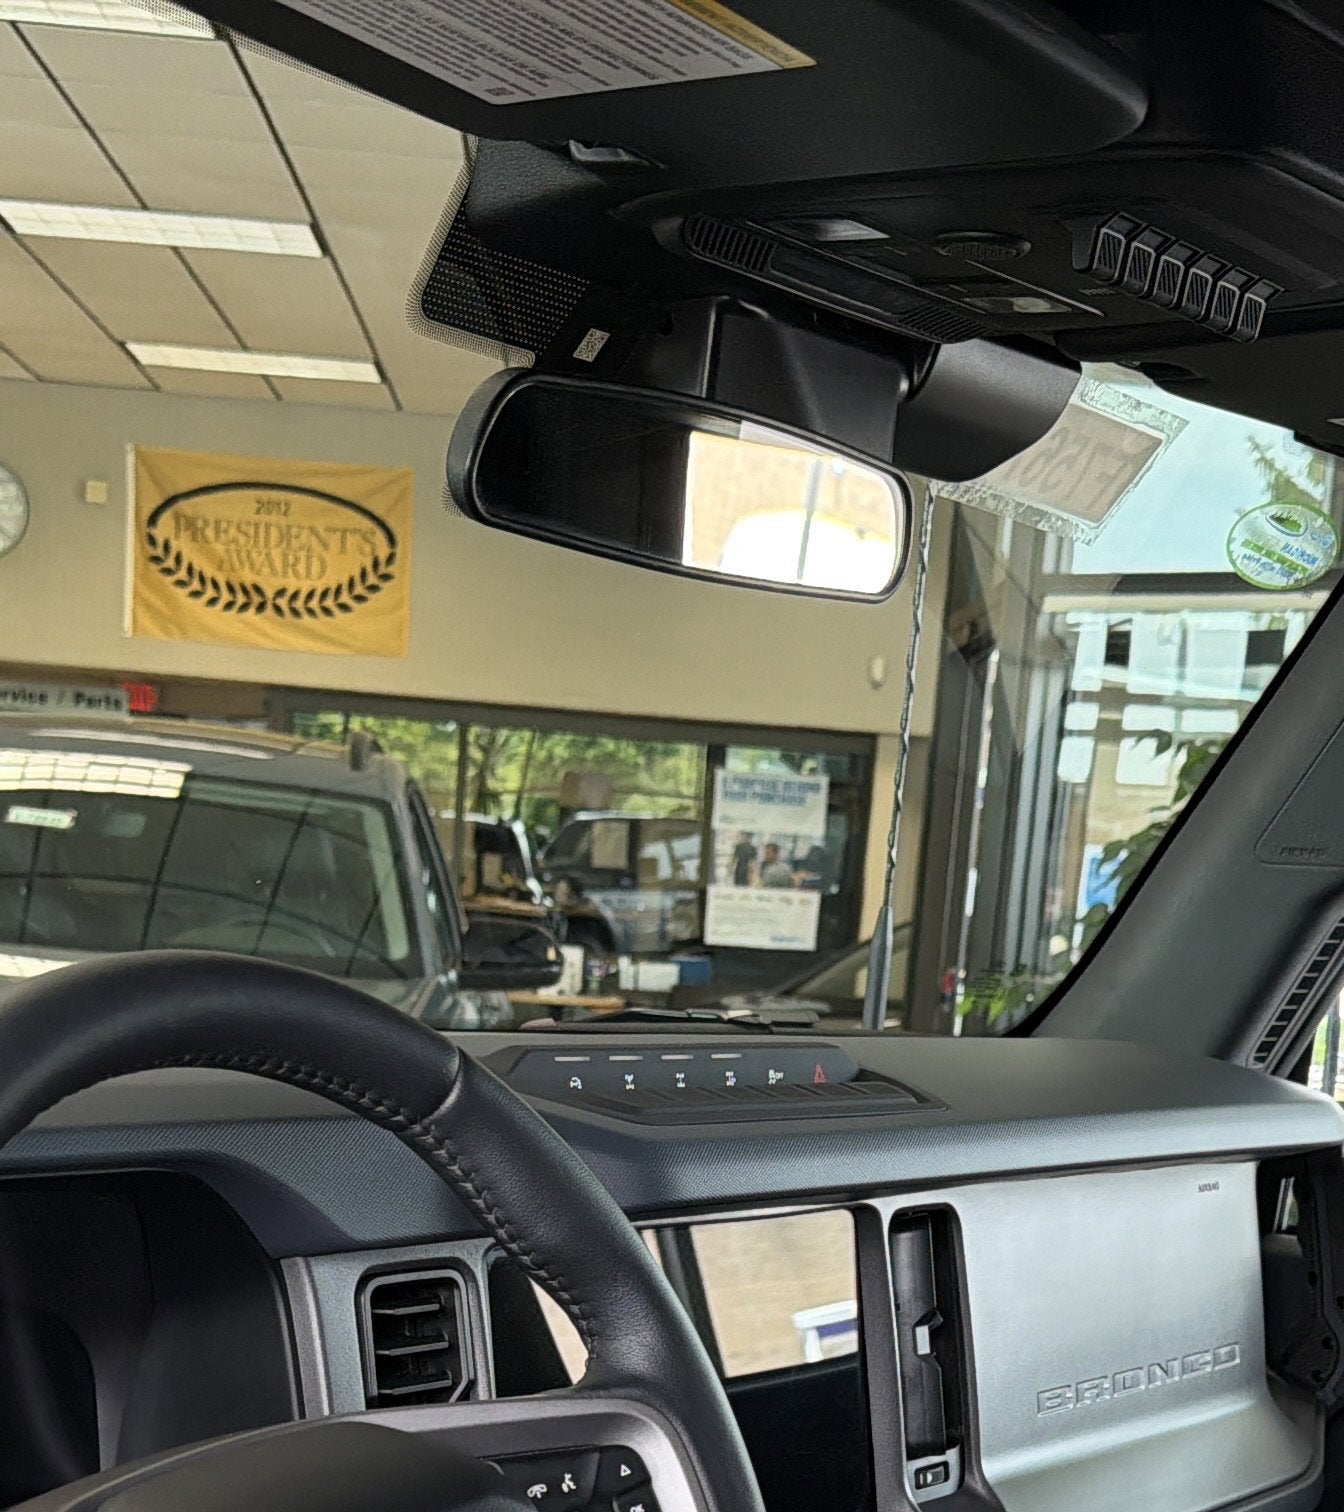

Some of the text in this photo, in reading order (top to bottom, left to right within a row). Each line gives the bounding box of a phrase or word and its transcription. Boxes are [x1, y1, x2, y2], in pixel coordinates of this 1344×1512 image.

[172, 511, 378, 557] PRESIDENT'S
[217, 545, 328, 581] AWARD
[74, 689, 122, 710] Parts
[1036, 1340, 1242, 1418] BRONCO
